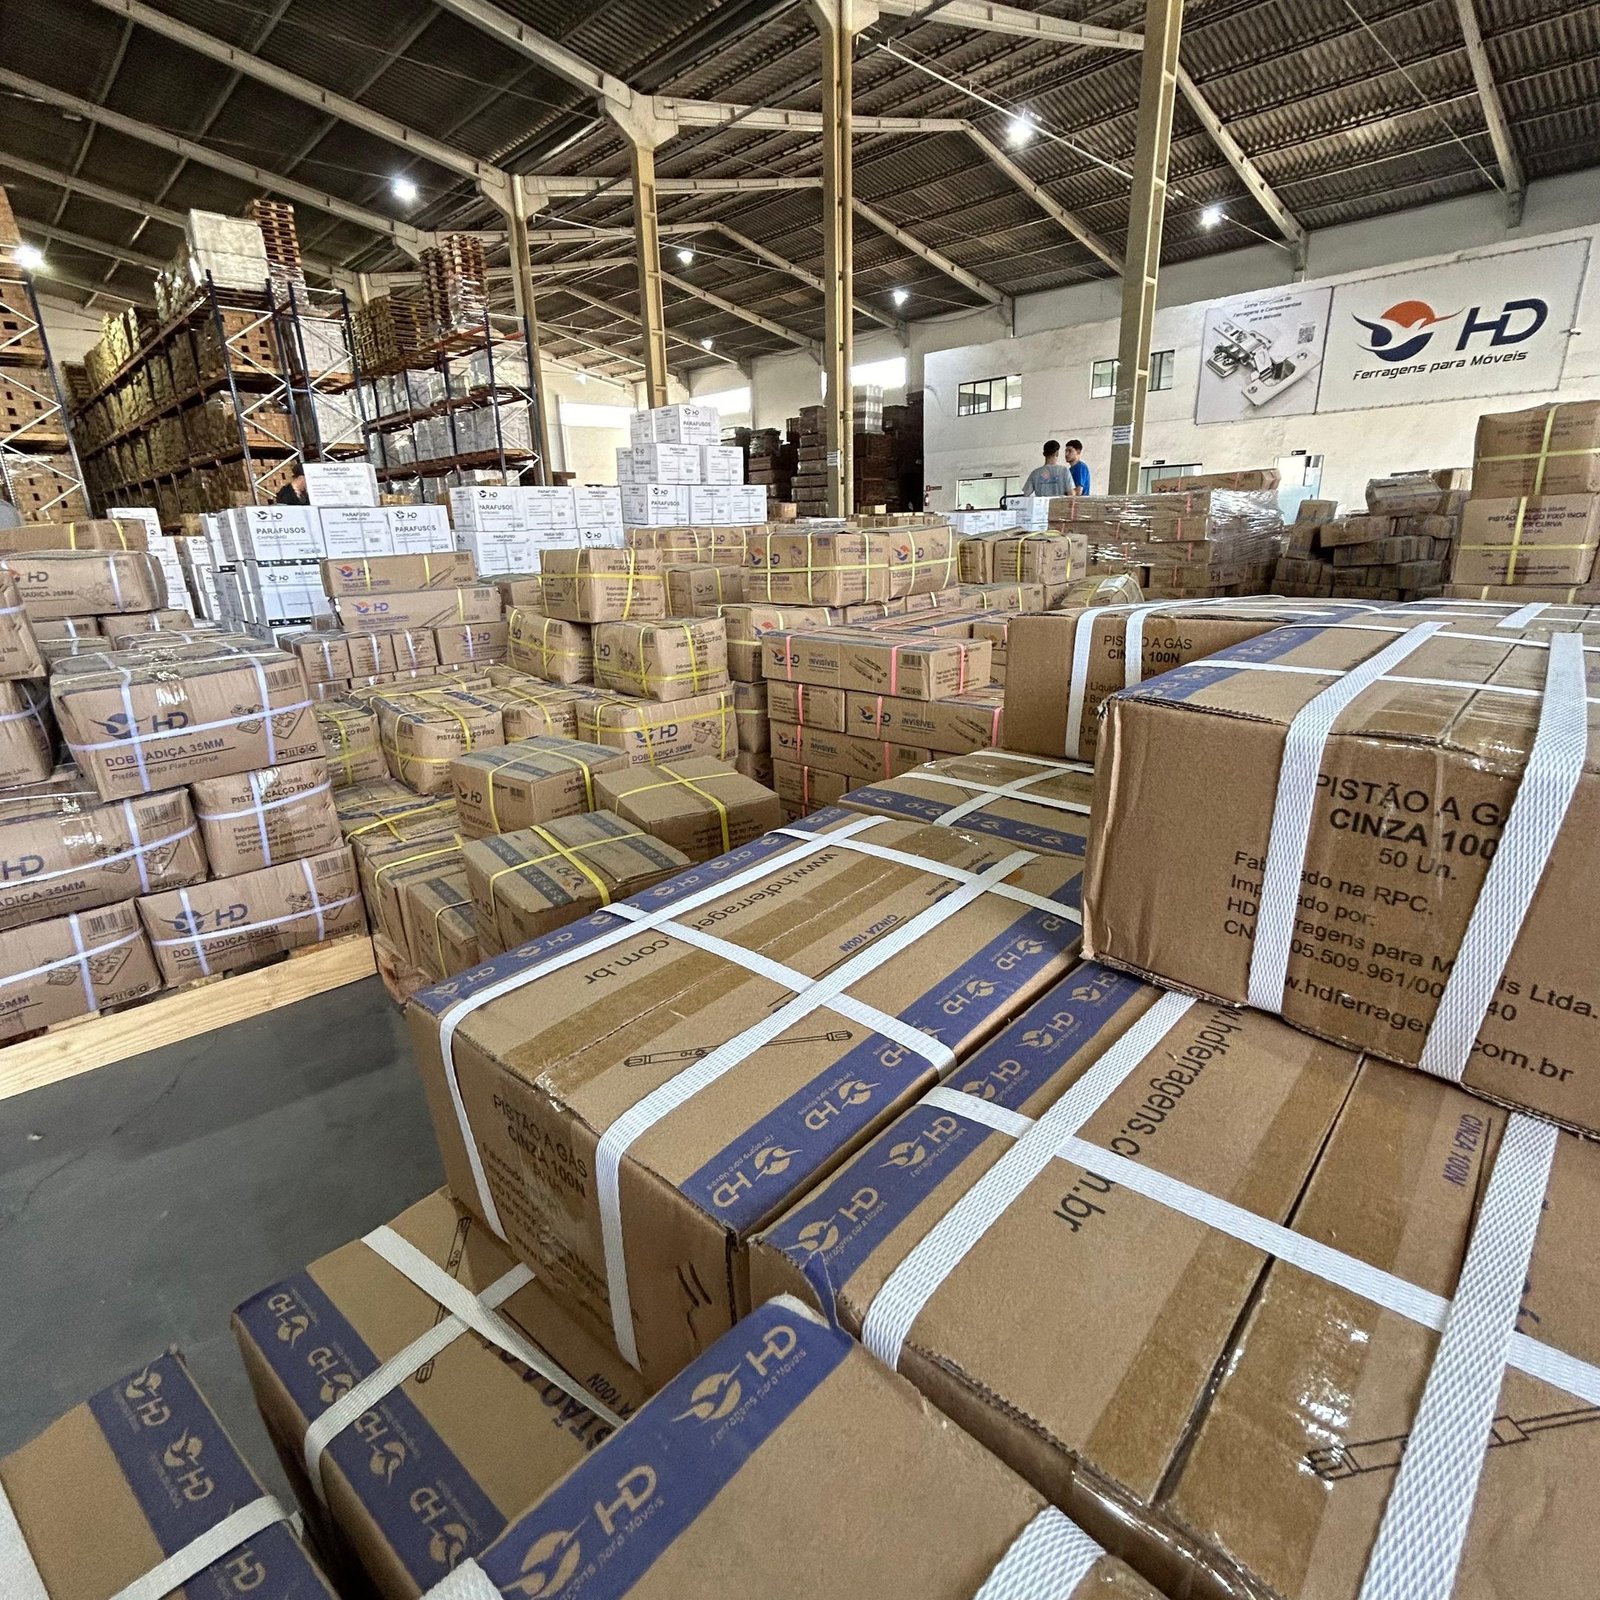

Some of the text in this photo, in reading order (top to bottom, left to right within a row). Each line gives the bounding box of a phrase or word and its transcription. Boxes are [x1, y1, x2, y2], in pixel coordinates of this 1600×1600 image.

[1265, 302, 1302, 312] Componentes
[1455, 298, 1549, 351] HD
[1353, 350, 1528, 381] Ferragens para Móveis
[256, 526, 306, 534] PARAFUSOS
[271, 512, 283, 520] HD
[395, 525, 437, 533] PARAFUSOS
[1522, 513, 1546, 521] ALÇO
[1567, 511, 1588, 519] INOX
[28, 571, 49, 582] HD
[374, 602, 389, 612] HD
[478, 632, 491, 641] HD
[1103, 635, 1193, 650] PISO A GÁS
[1148, 651, 1180, 663] 100N
[152, 711, 189, 734] HD
[660, 723, 679, 739] HD
[436, 734, 460, 742] PISTÃO
[104, 738, 225, 769] DOBADIÇA 35MM
[189, 754, 220, 768] CURVA
[632, 748, 675, 763] DOBADIÇA
[675, 743, 693, 754] 35MM
[265, 786, 296, 798] CALÇO
[296, 781, 315, 791] FIXO
[1316, 772, 1430, 813] PISTÃO
[1439, 802, 1462, 821] A
[1328, 806, 1500, 860] CINZA 100
[3, 854, 45, 881] HD
[732, 850, 753, 862] HD
[1378, 847, 1458, 880] 50 Un.
[0, 880, 87, 909] DICA 35MM
[677, 875, 700, 887] HD
[1234, 850, 1434, 915] Fabado na RPC.
[1231, 874, 1377, 927] Impado por:
[215, 903, 249, 927] HD
[547, 931, 575, 948] HD
[839, 913, 899, 953] CINZA 100N
[1224, 919, 1254, 940] CN
[996, 951, 1022, 971] HD
[1227, 896, 1599, 1020] HD para Mis Ltda.
[467, 965, 496, 983] HD
[1093, 972, 1119, 988] HD
[943, 993, 971, 1015] HD
[1045, 1011, 1075, 1033] HD
[990, 1059, 1022, 1082] HD
[492, 1093, 541, 1143] PISTÃO
[544, 1134, 555, 1152] A
[805, 1100, 841, 1131] HD
[923, 1115, 958, 1144] HD
[506, 1125, 551, 1170] CINZA
[552, 1159, 587, 1198] 100N
[1442, 1113, 1484, 1188] CINZA 100N
[712, 1169, 753, 1208] HD
[838, 1186, 880, 1222] HD
[267, 1292, 295, 1318] HD
[307, 1346, 340, 1377] HD
[746, 1324, 798, 1377] HD
[586, 1372, 622, 1406] 100N
[755, 1374, 780, 1403] para
[137, 1396, 172, 1427] HD
[353, 1409, 389, 1443] HD
[177, 1466, 215, 1501] HD
[410, 1486, 448, 1525] HD
[594, 1463, 659, 1536] HD
[598, 1533, 626, 1568] para
[226, 1549, 267, 1591] HD
